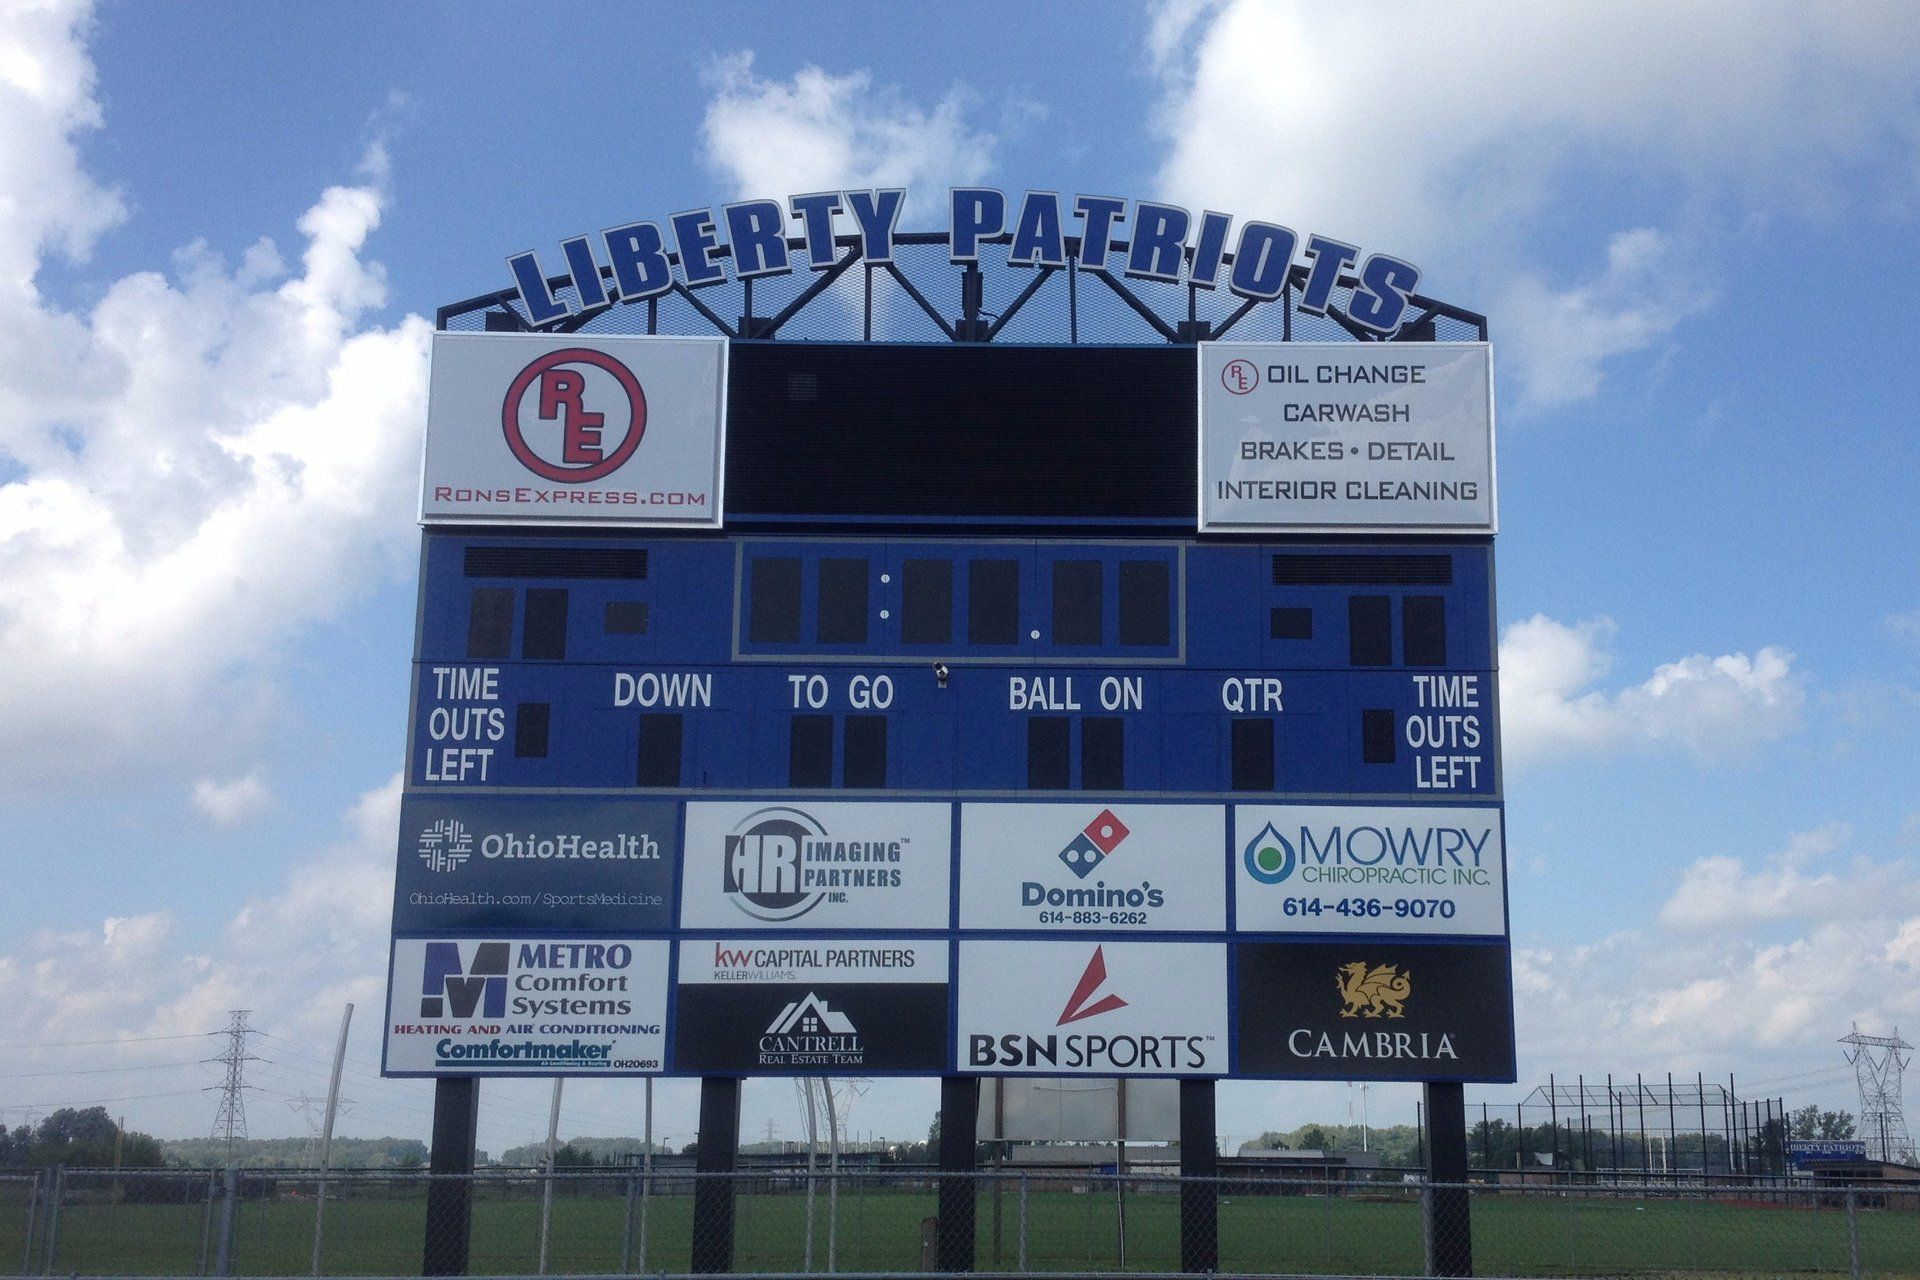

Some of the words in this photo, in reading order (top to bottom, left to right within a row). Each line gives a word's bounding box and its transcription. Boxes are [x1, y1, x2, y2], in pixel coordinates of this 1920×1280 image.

[505, 187, 906, 327] LIBERTY
[949, 187, 1422, 334] PATRIOTS
[1267, 365, 1309, 384] OIL
[1316, 365, 1427, 384] CHANGE
[1283, 404, 1410, 423] CARWASH
[1241, 441, 1344, 461] BRAKES
[1367, 442, 1455, 462] DETAIL
[1218, 480, 1336, 500] INTERIOR
[1346, 481, 1478, 501] CLEANING
[433, 667, 499, 699] TIME
[613, 673, 712, 708] DOWN
[788, 675, 829, 708] TO
[848, 675, 895, 709] GO
[1009, 677, 1081, 710] BALL
[1100, 677, 1143, 710] ON
[1222, 678, 1284, 712] QTR
[1412, 675, 1479, 708] TIME
[429, 707, 506, 741] OUTS
[1405, 715, 1482, 749] OUTS
[425, 748, 495, 782] LEFT
[1415, 756, 1482, 789] LEFT
[480, 833, 661, 860] OhioHealth
[806, 841, 901, 863] IMAGING
[1300, 826, 1491, 867] MOWRY
[804, 868, 902, 887] PARTNERS
[1302, 866, 1447, 885] CHIROPRACTIC
[1453, 868, 1491, 886] INC.
[409, 892, 663, 908] OhioHealth.com/SportsMedicine
[828, 892, 848, 903] INC.
[1021, 880, 1164, 908] Domino's
[1039, 911, 1147, 925] 614-883-6262
[1282, 897, 1456, 919] 614-436-9070
[516, 943, 633, 970] METRO
[754, 949, 823, 968] CAPITAL
[826, 949, 915, 968] PARTNERS
[514, 973, 628, 992] Comfort
[512, 997, 632, 1018] Systems
[394, 1024, 462, 1034] HEATING
[467, 1024, 501, 1034] AND
[506, 1024, 533, 1034] AIR
[539, 1024, 661, 1035] CONDITIONING
[435, 1038, 612, 1060] Comfortmaker
[758, 1036, 864, 1052] CANTRELL
[969, 1034, 1057, 1067] BSN
[1065, 1034, 1206, 1069] SPORTS
[1288, 1029, 1459, 1060] CAMBRIA
